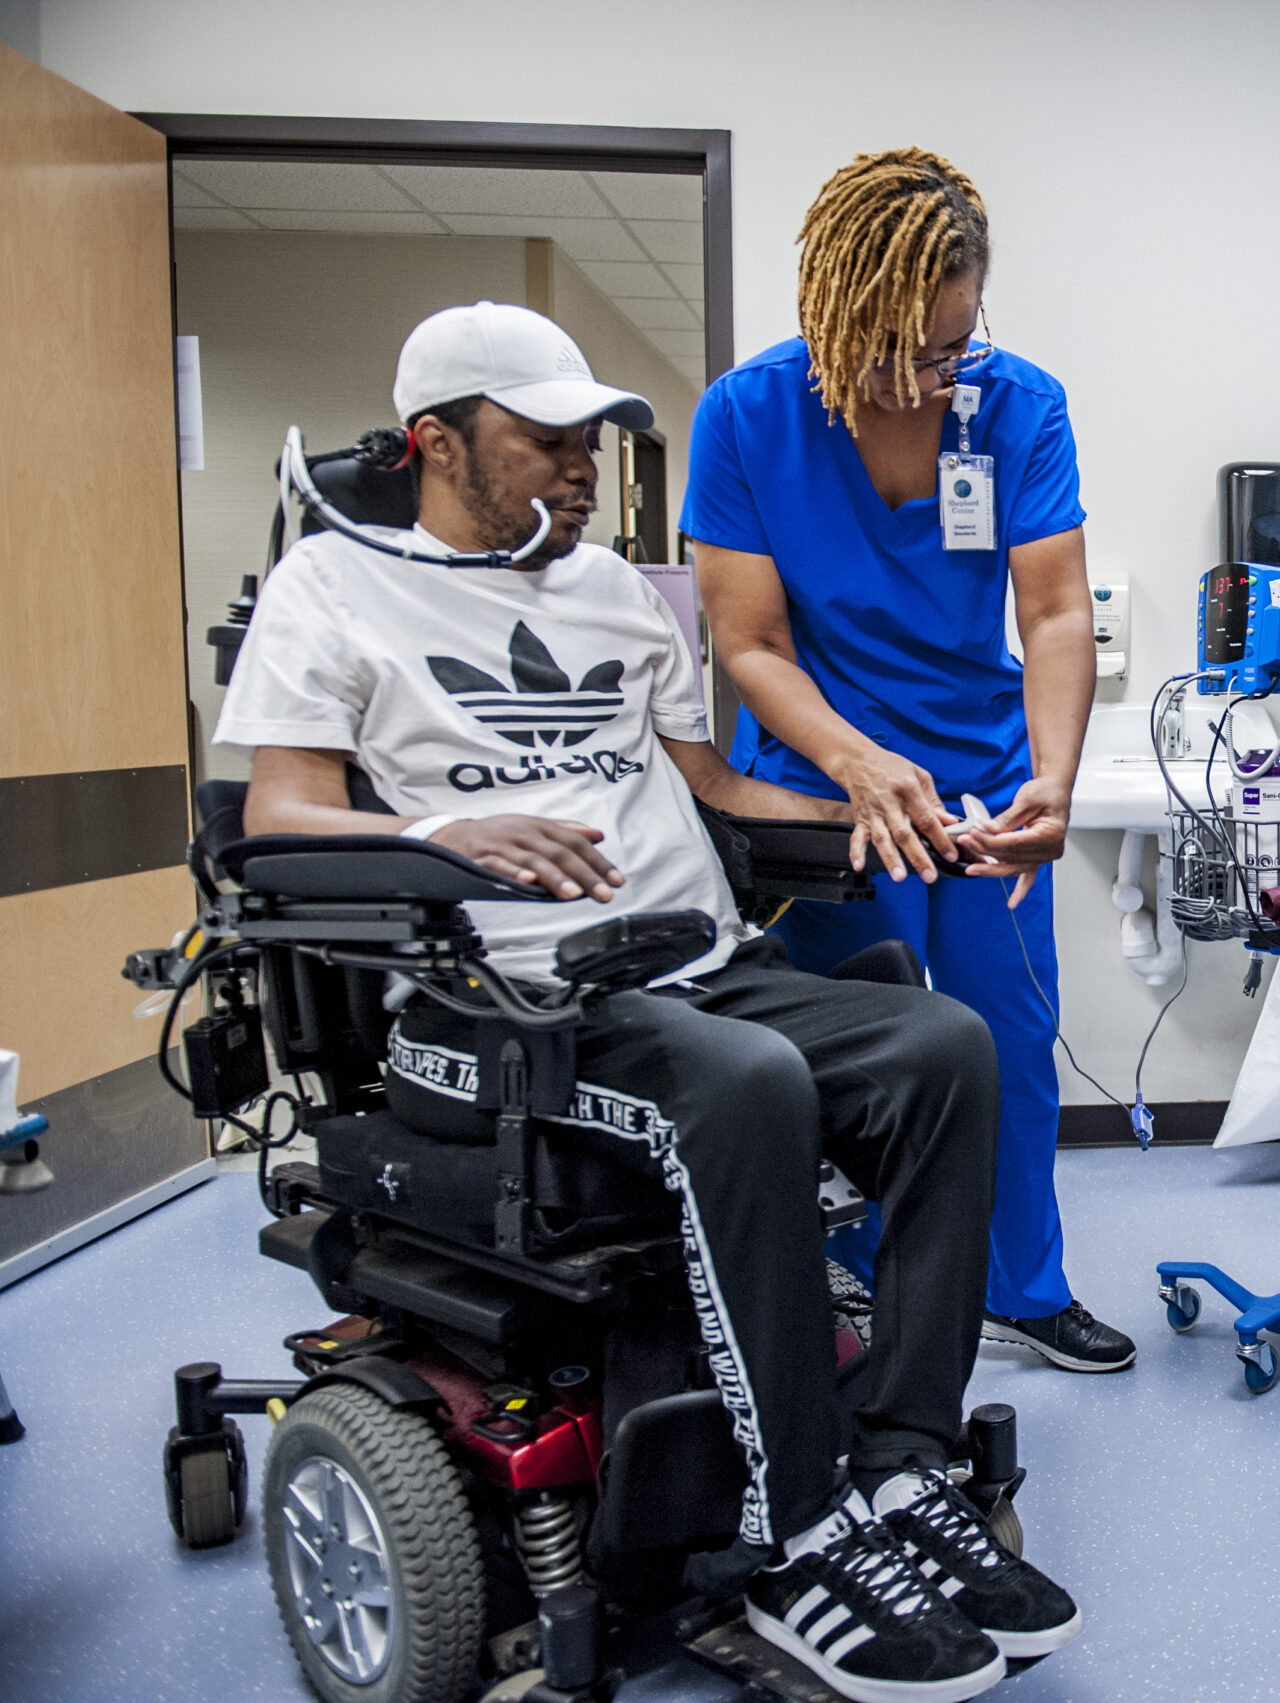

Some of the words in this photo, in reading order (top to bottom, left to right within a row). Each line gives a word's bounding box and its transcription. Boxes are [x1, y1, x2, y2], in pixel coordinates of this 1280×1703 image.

[446, 750, 645, 793] adidas
[1243, 791, 1259, 799] Super
[598, 1097, 637, 1132] THE
